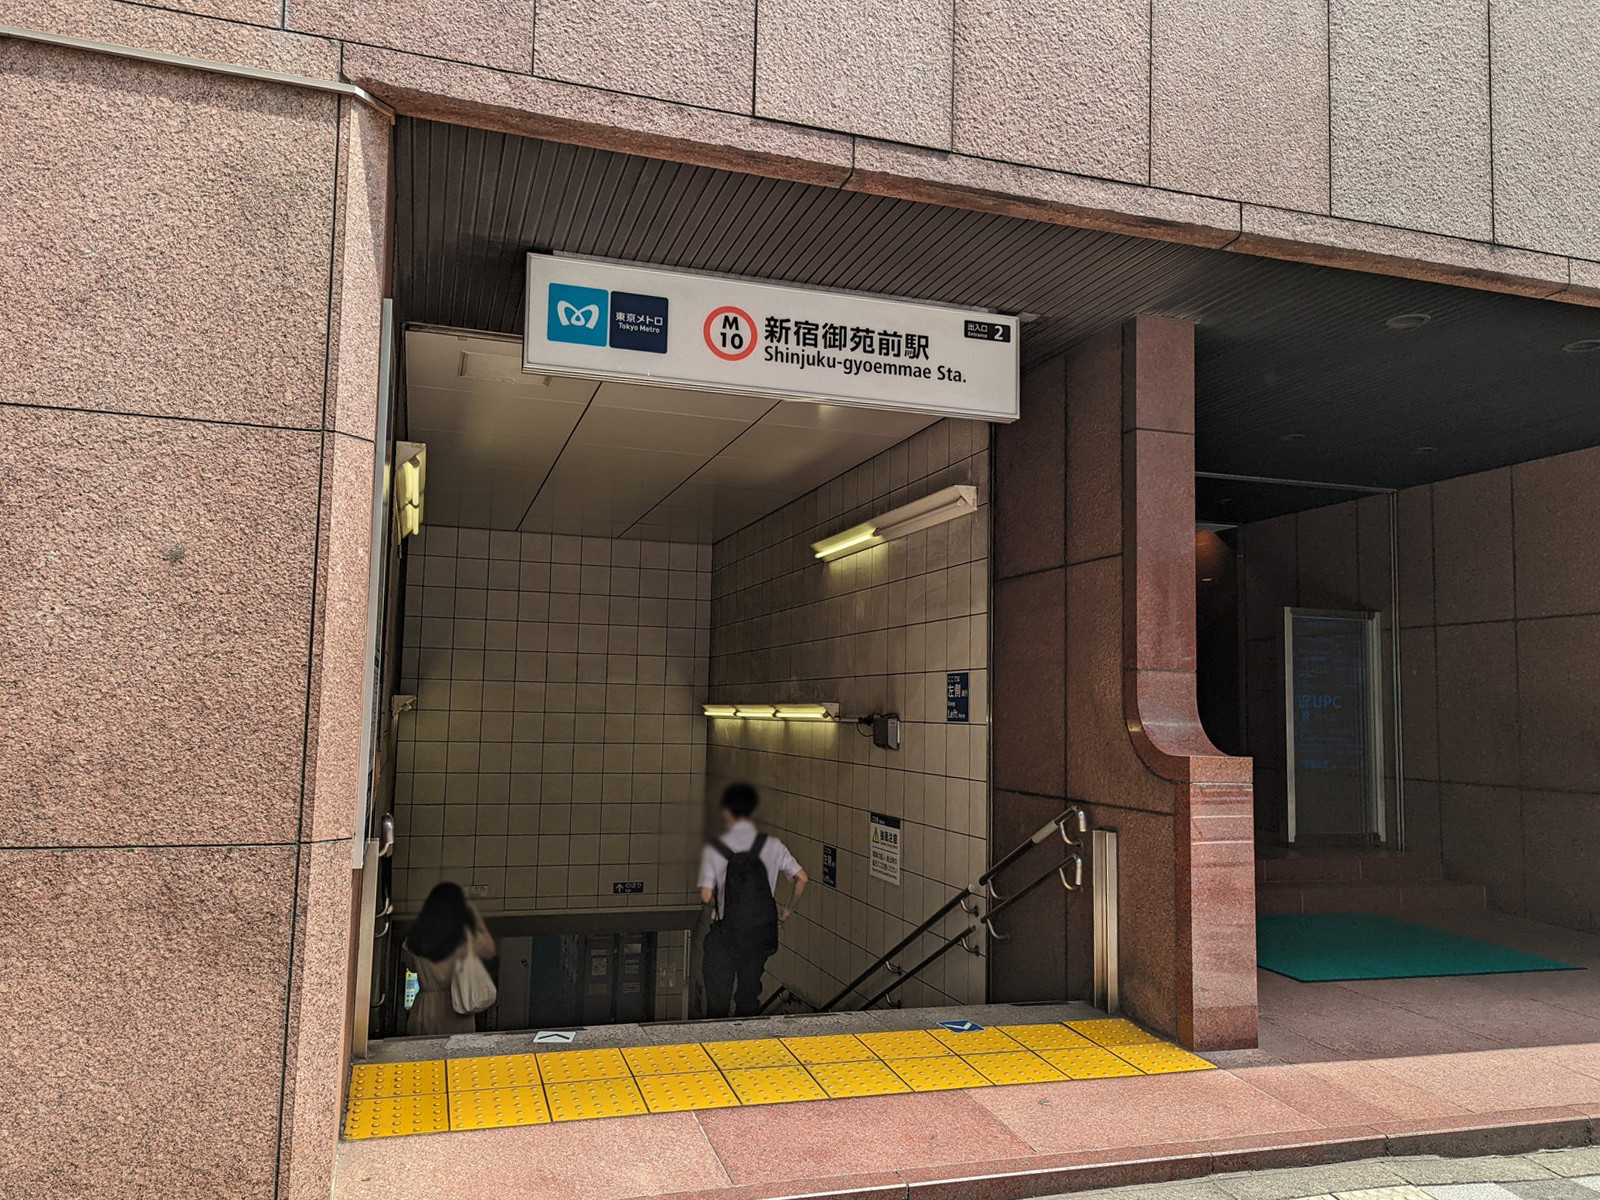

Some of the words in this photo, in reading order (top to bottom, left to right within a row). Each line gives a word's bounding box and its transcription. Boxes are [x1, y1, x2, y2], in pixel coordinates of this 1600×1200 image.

[615, 311, 663, 326] 東京メトロ
[722, 315, 739, 331] M
[618, 322, 638, 331] Tokyo
[639, 325, 660, 334] Metro
[967, 323, 988, 333] 出入口
[994, 325, 1004, 340] 2
[720, 332, 744, 350] 10
[764, 316, 929, 360] 新宿御苑前駅
[764, 346, 932, 379] Shinjuku-gyoemmae
[937, 365, 967, 383] Sta.
